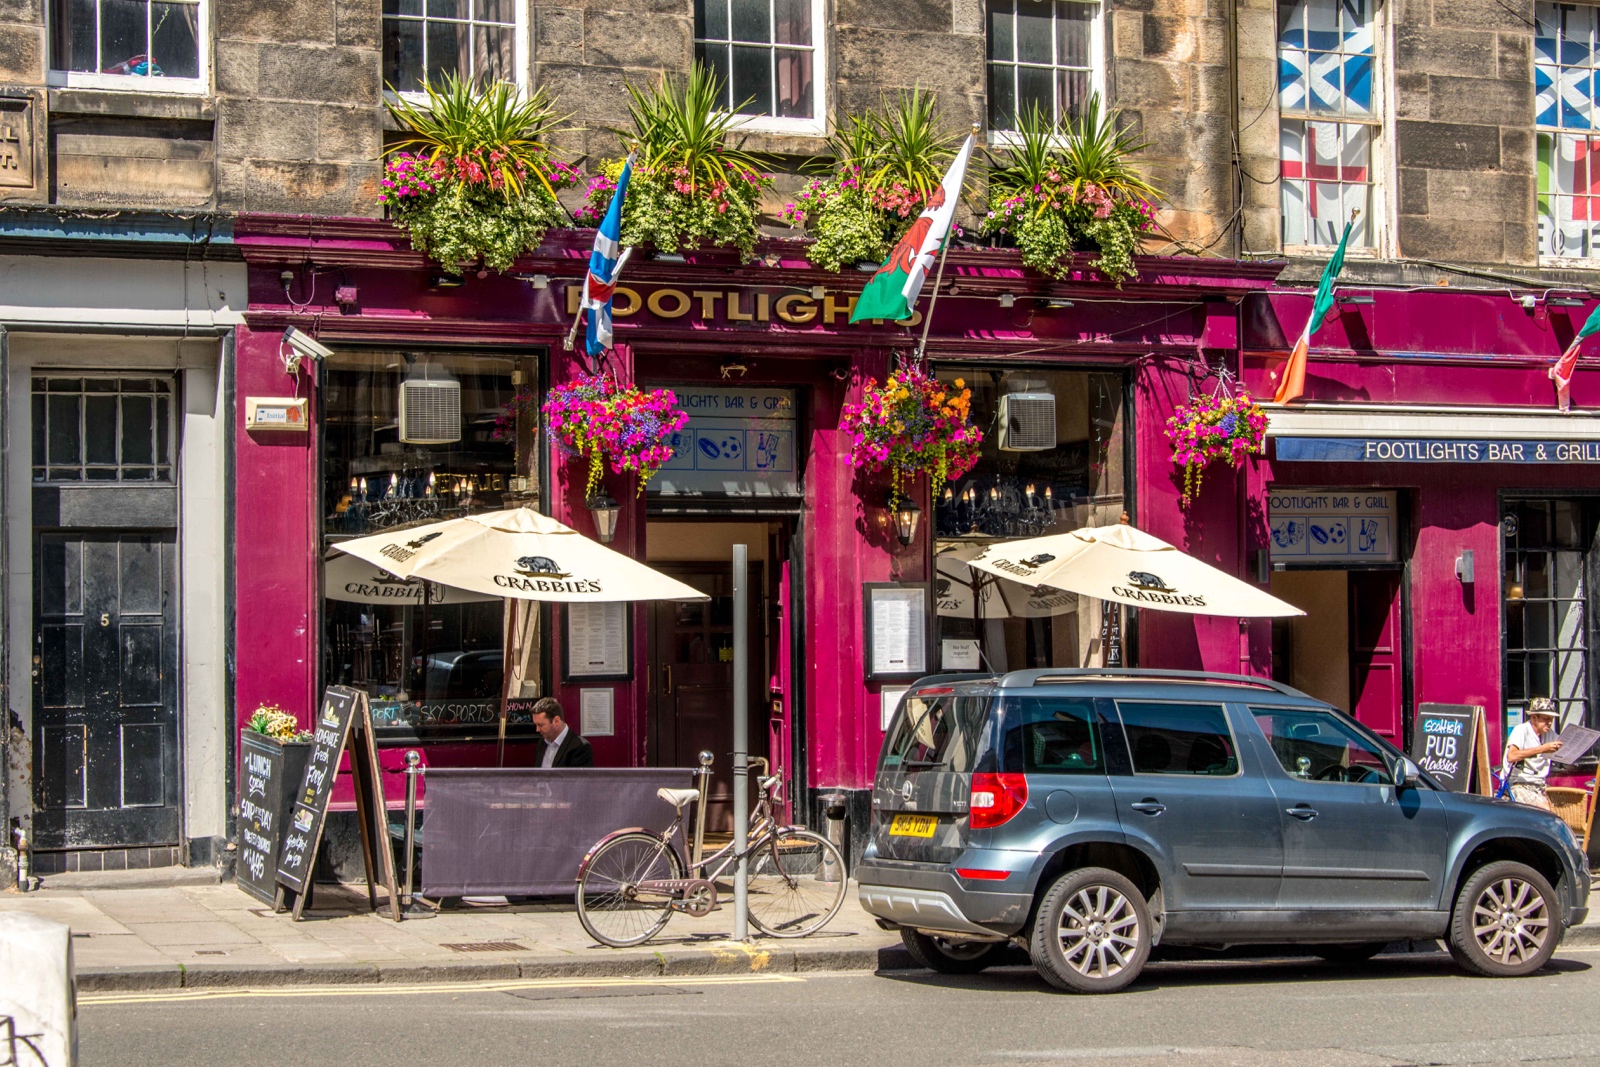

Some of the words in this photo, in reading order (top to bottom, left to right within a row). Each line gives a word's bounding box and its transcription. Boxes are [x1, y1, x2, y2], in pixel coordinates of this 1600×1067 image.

[567, 285, 923, 327] FOOTLIGHS
[725, 395, 744, 408] BAR
[750, 396, 758, 409] &
[1365, 441, 1479, 460] FOOTLIGHTS
[1488, 443, 1525, 460] BAR
[1535, 443, 1548, 460] &
[1270, 496, 1328, 508] OOTLIGHTS
[1332, 496, 1349, 508] BAR
[1354, 496, 1361, 508] &
[1365, 496, 1389, 509] GRILL
[493, 574, 602, 594] CRABBIE'S
[1111, 586, 1207, 607] CRABBIE'S
[101, 612, 110, 627] 5
[420, 703, 446, 722] SKY
[447, 703, 494, 723] SPORTS
[1425, 718, 1461, 735] Scottish
[1425, 735, 1457, 759] PUB
[249, 751, 272, 779] LUNCH
